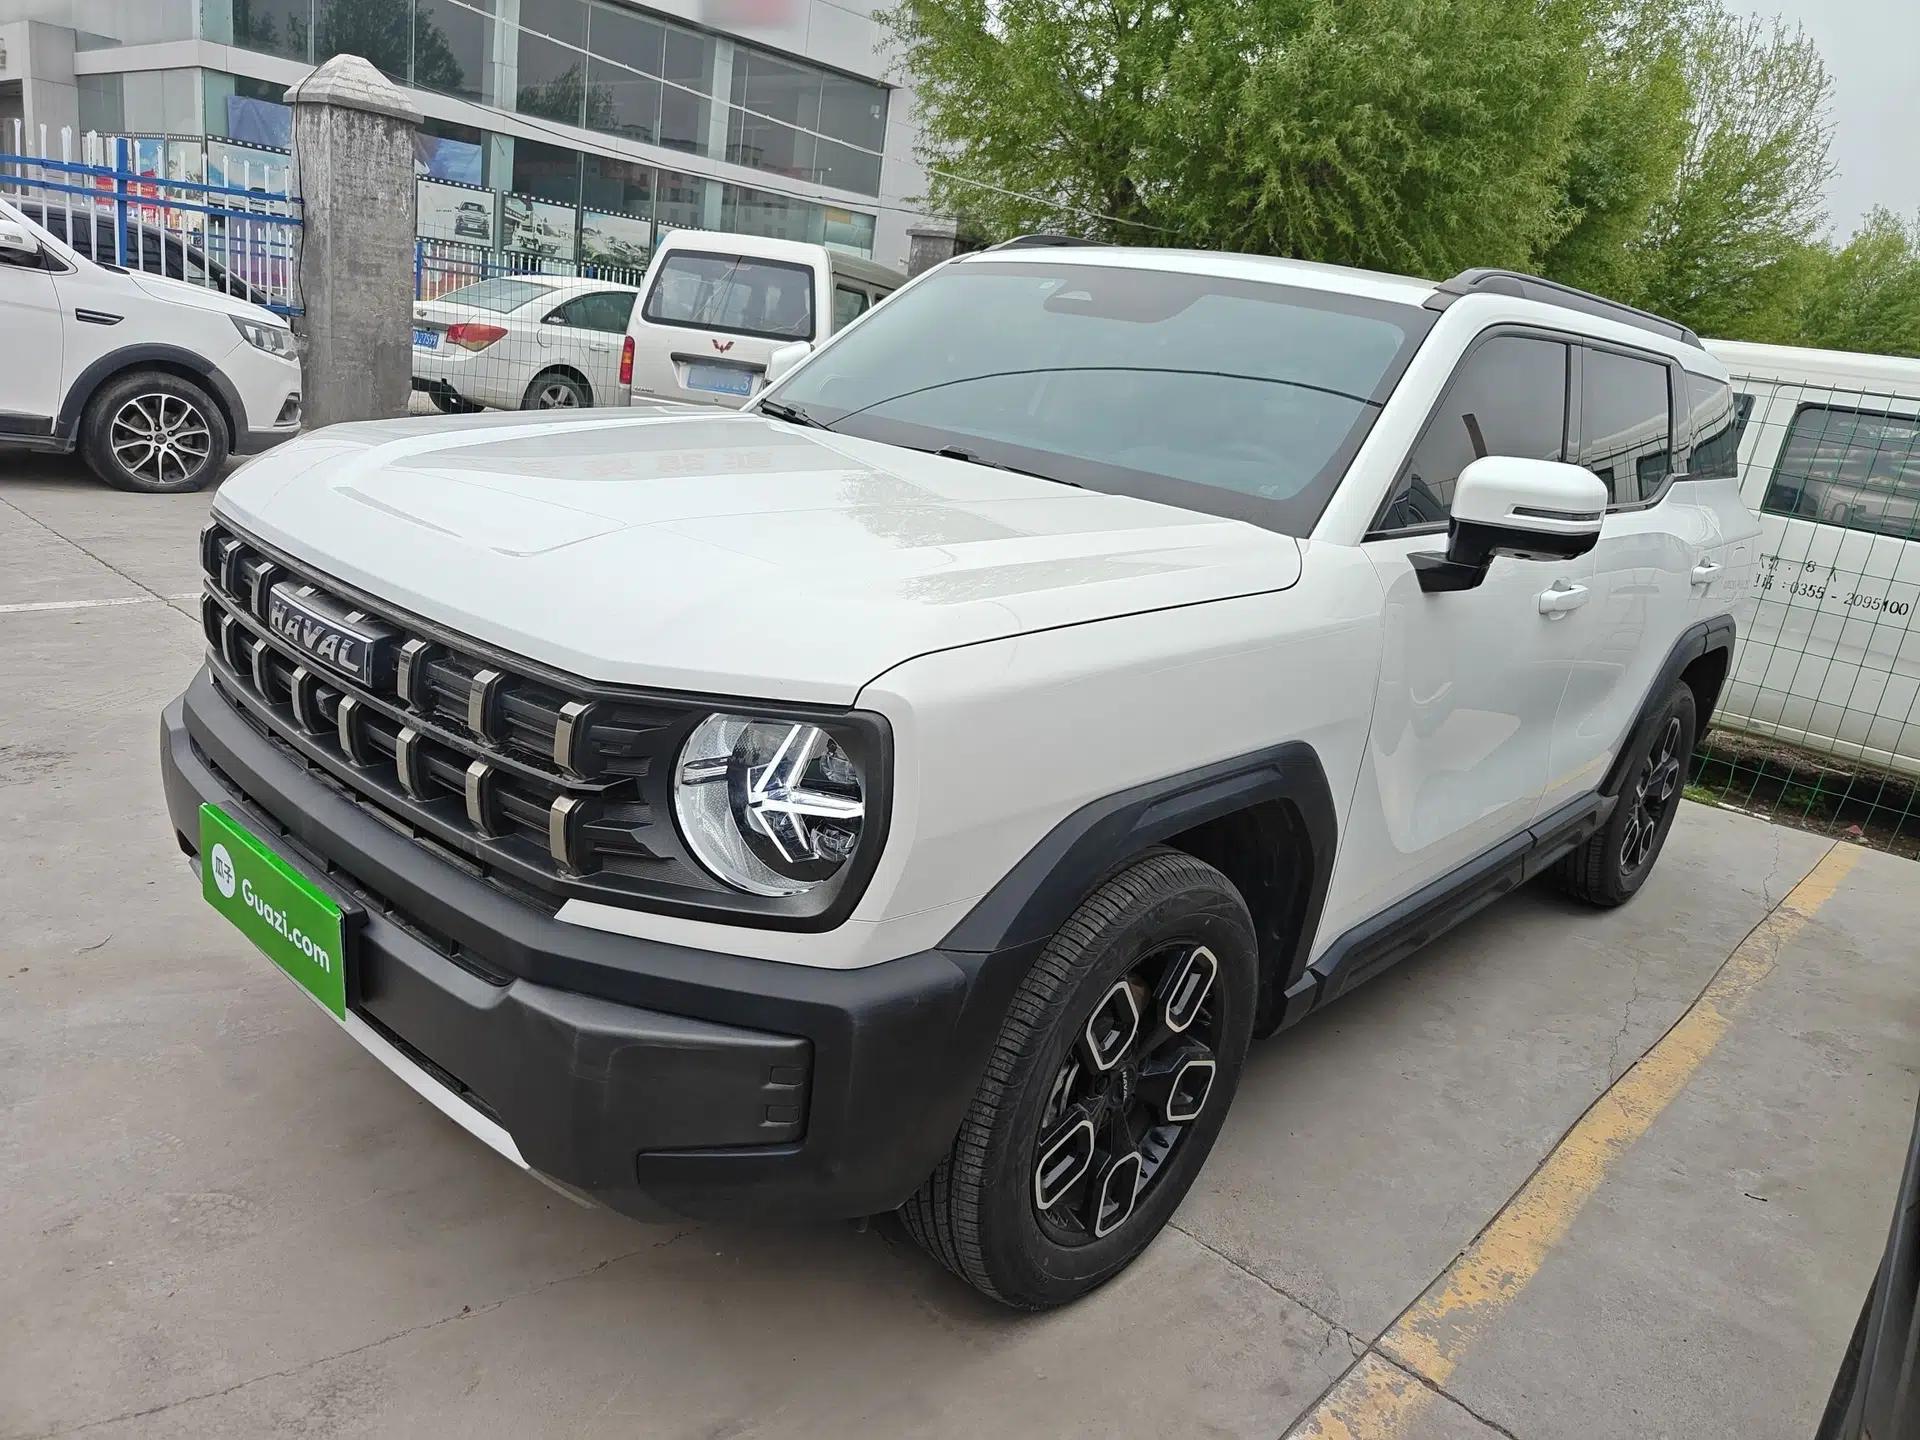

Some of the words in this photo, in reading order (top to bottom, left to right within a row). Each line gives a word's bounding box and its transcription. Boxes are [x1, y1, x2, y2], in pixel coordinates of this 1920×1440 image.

[1805, 560, 1817, 573] 8
[270, 601, 361, 673] HAVAL
[214, 855, 234, 884] 瓜子
[241, 878, 330, 974] Guazi.com
